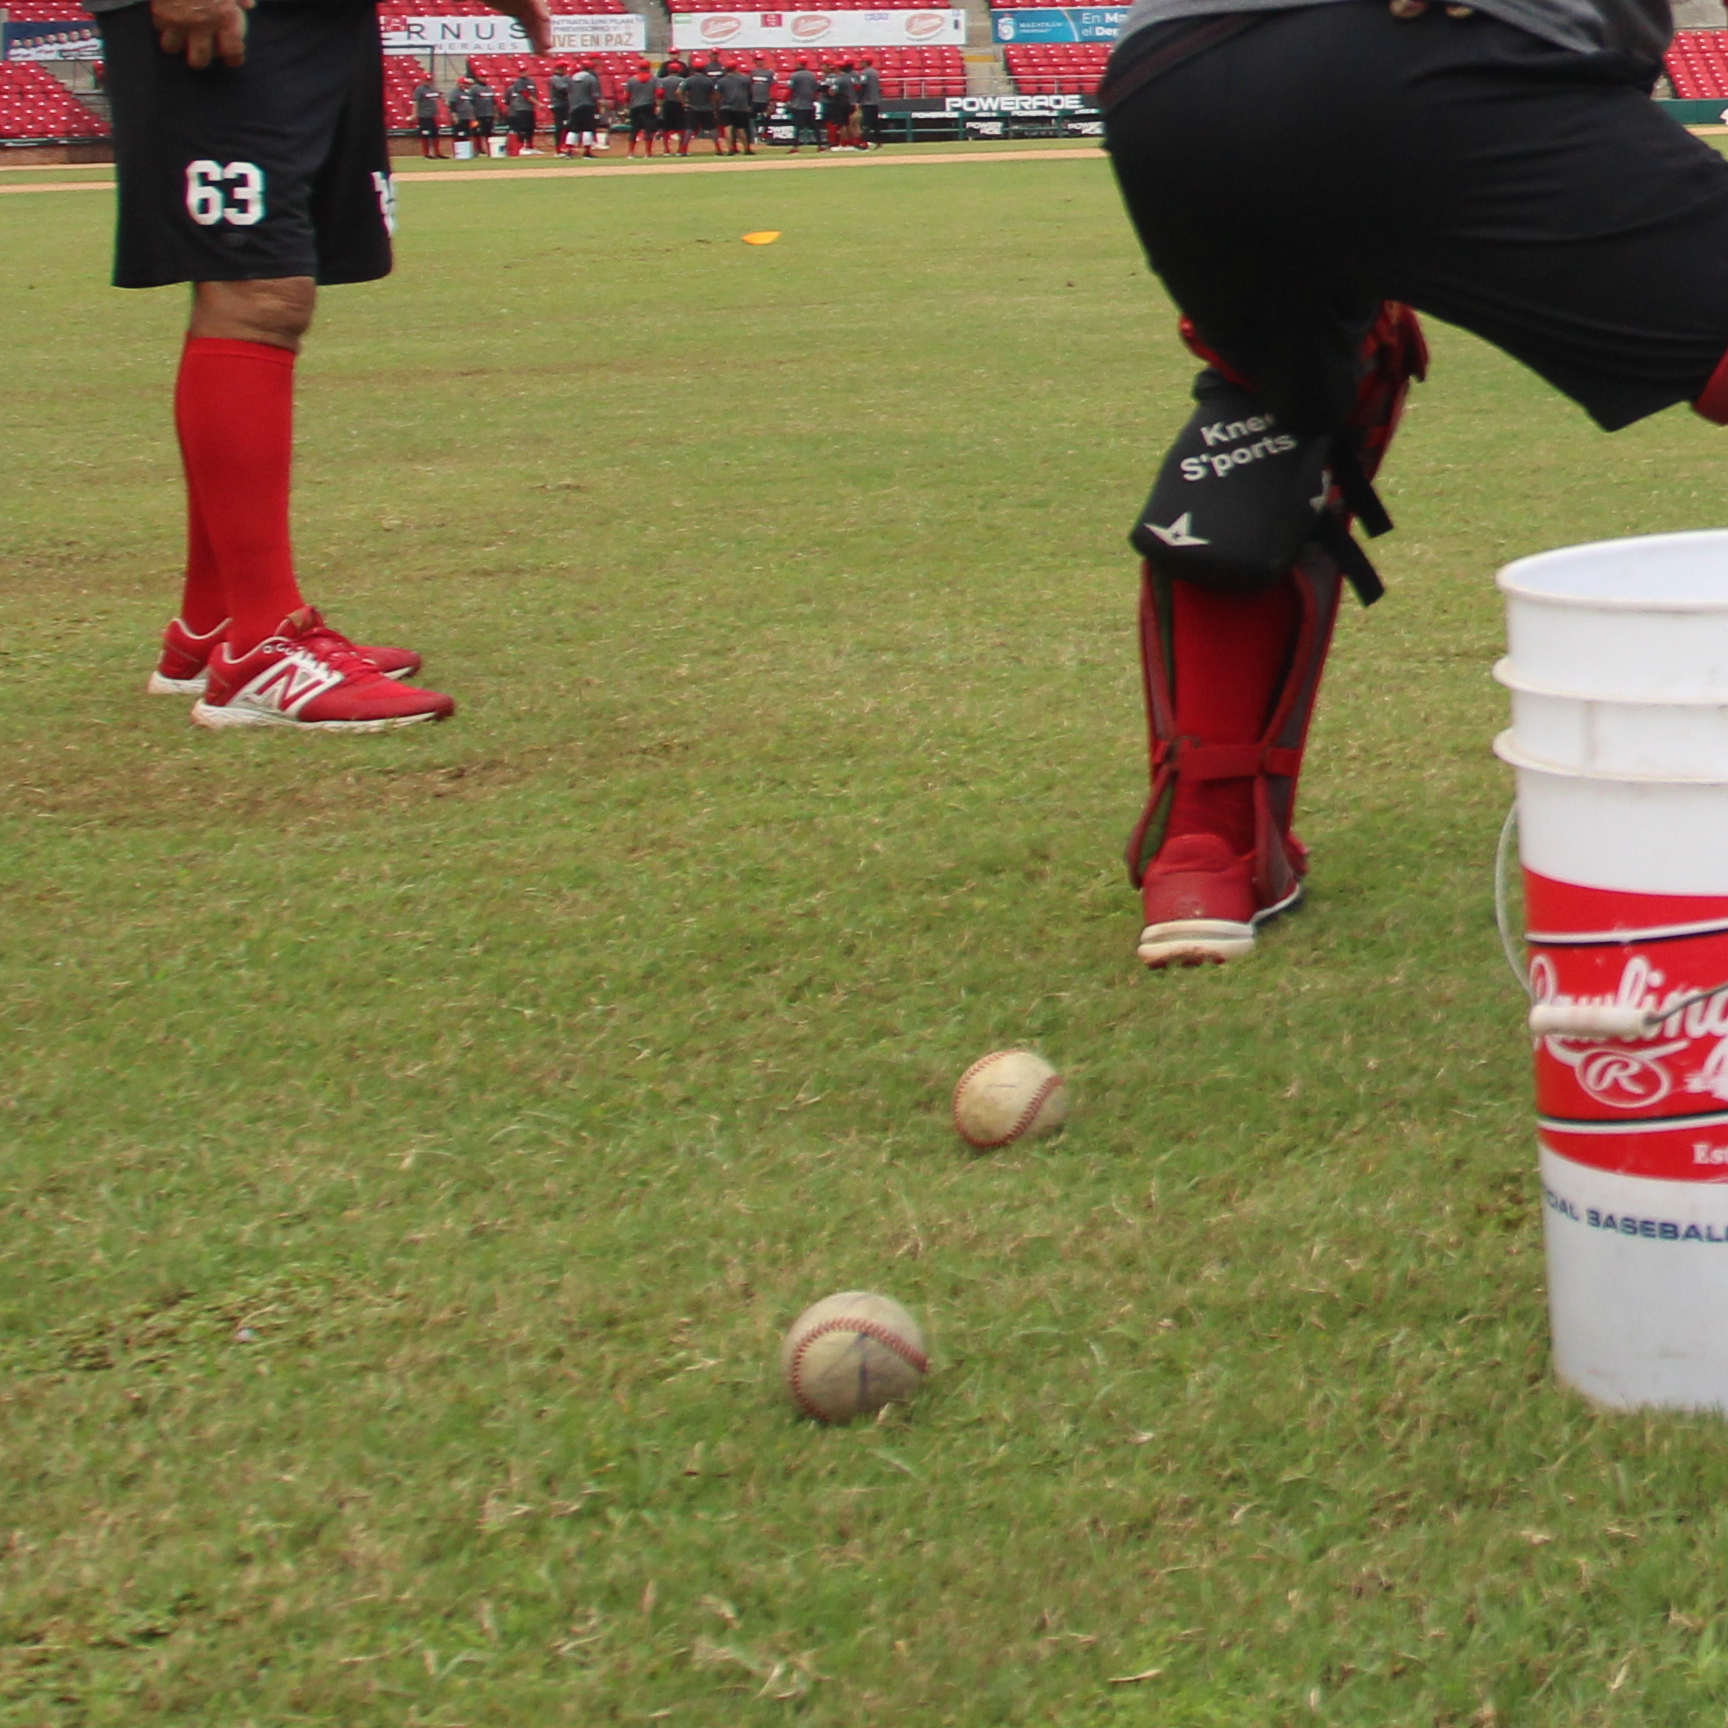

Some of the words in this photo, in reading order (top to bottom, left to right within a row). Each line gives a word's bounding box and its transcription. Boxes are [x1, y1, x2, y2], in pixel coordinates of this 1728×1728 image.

[1082, 13, 1100, 24] En
[1082, 26, 1094, 37] el
[581, 34, 600, 47] EN
[605, 32, 634, 47] PAZ
[945, 94, 1084, 111] POWERADE
[186, 159, 266, 225] 63
